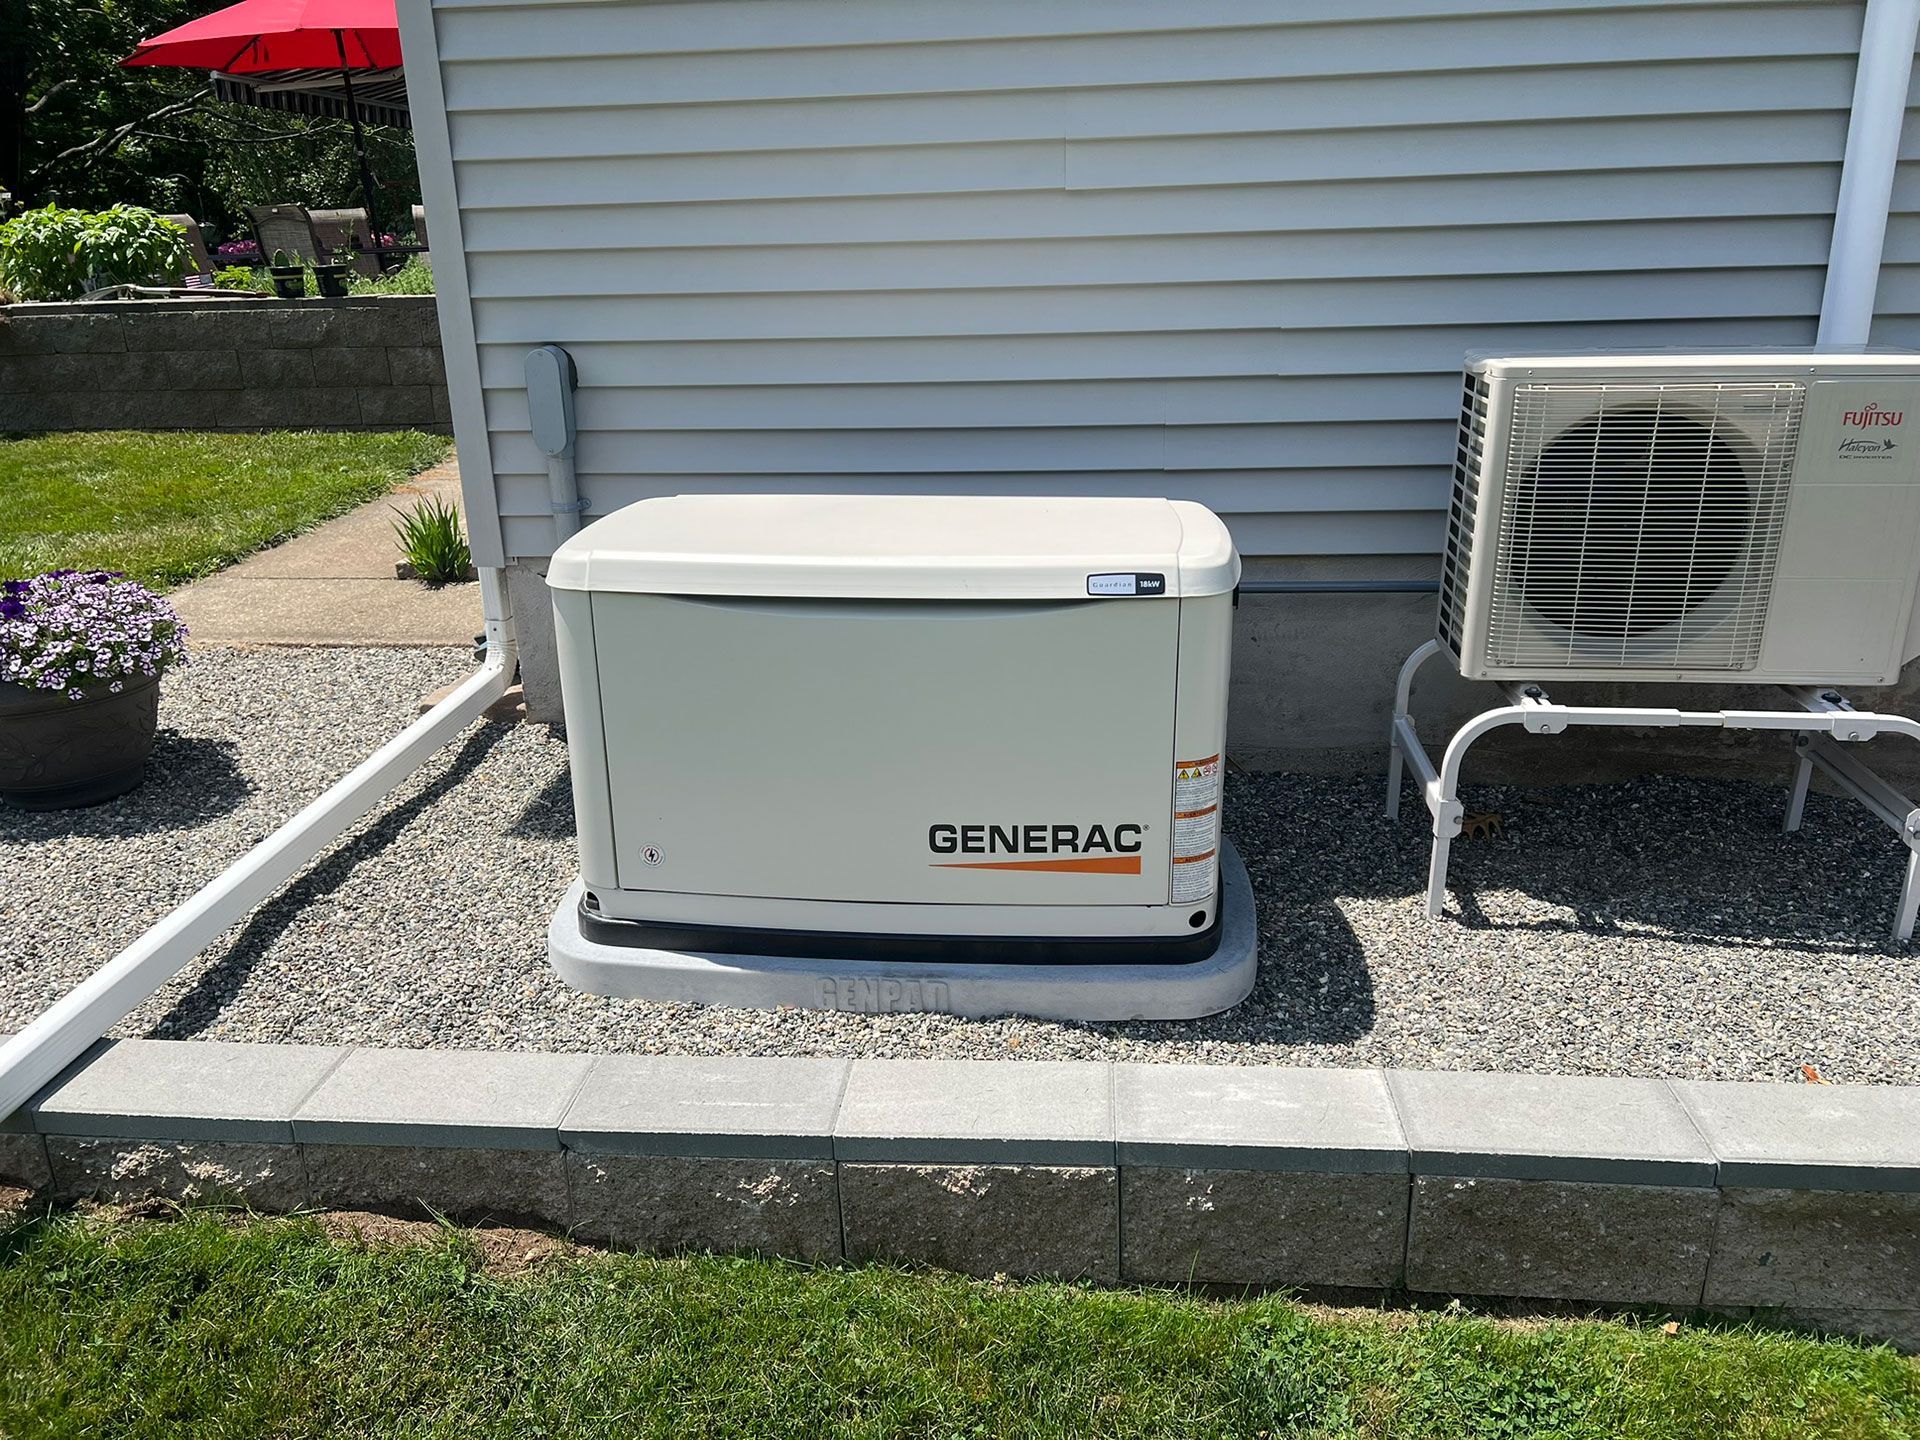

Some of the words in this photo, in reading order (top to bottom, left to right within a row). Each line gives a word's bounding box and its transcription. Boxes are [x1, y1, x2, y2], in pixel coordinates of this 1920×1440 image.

[1842, 405, 1903, 429] FUJITSU
[1838, 438, 1881, 453] Halcyon
[1092, 581, 1133, 589] Guardian
[1139, 580, 1161, 588] 18kW
[928, 823, 1142, 854] GENERAC
